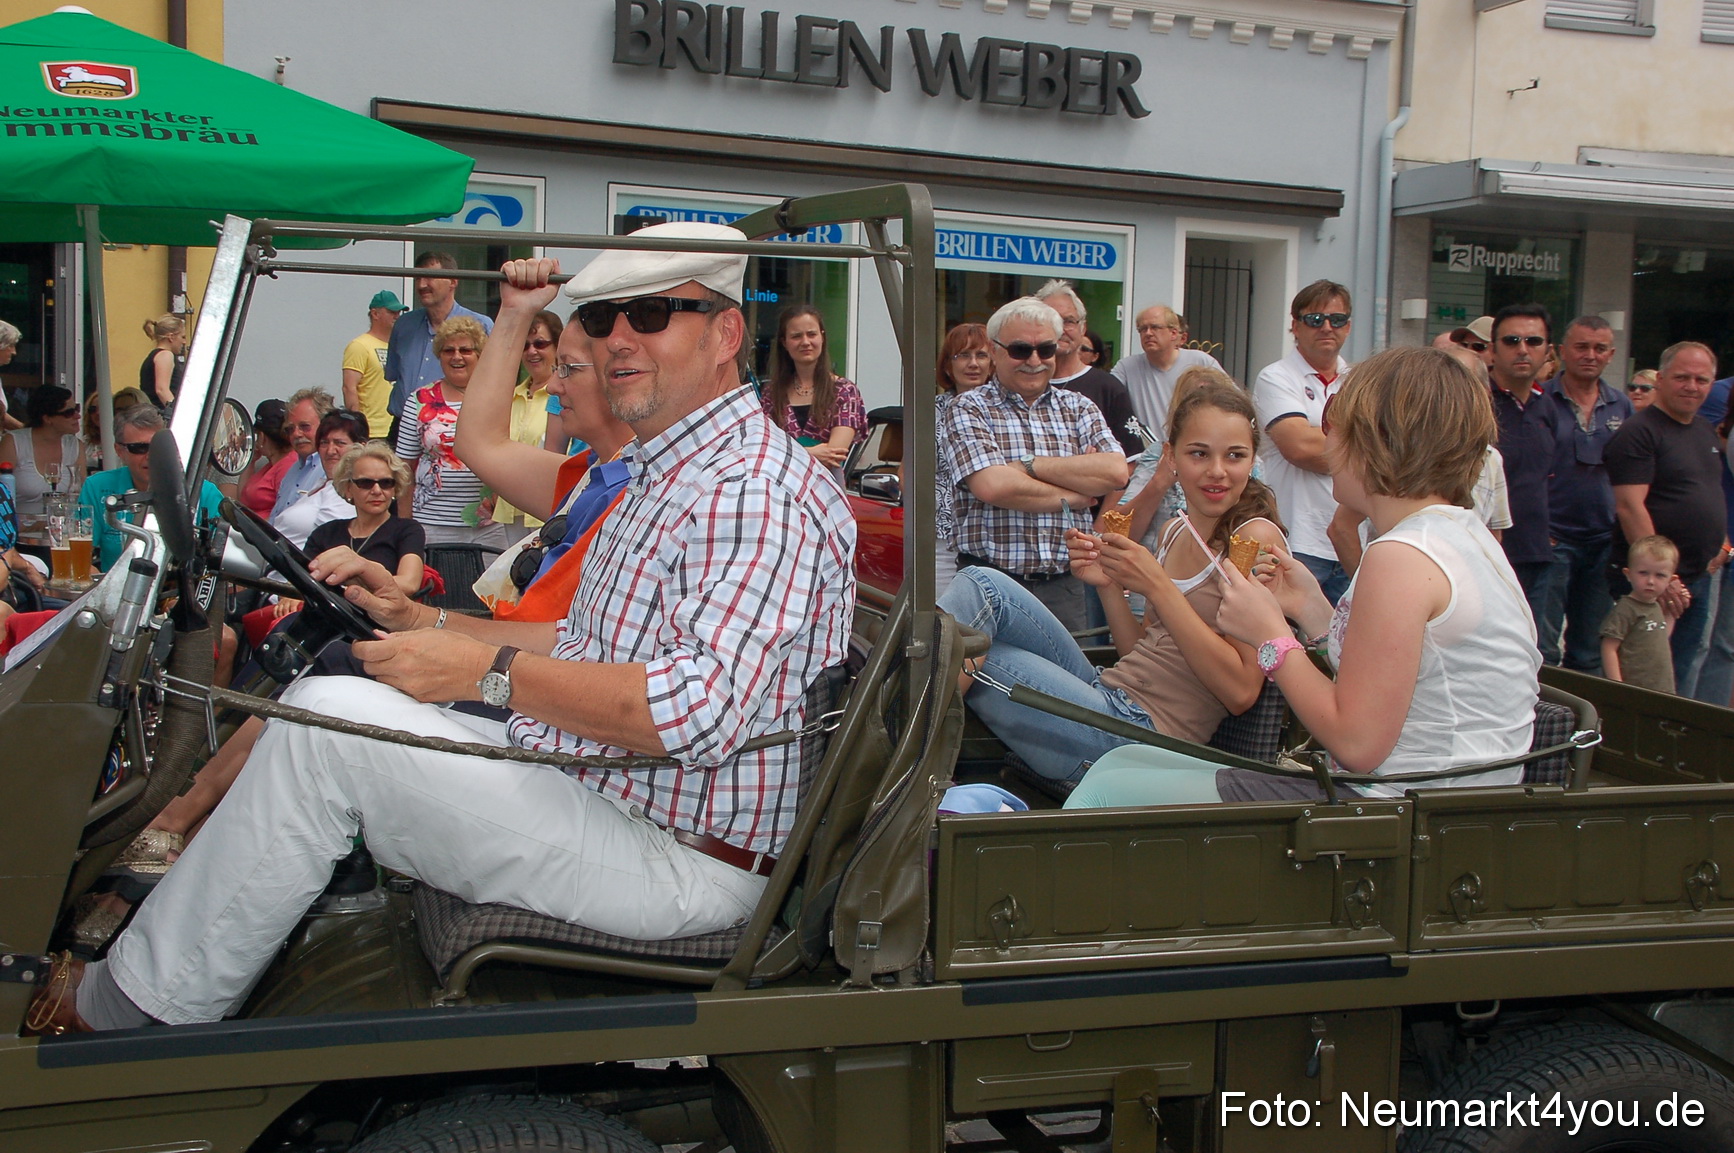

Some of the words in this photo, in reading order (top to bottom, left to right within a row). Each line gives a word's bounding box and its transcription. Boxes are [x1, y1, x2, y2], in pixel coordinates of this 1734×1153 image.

[612, 0, 895, 93] BRILLEN
[906, 26, 1152, 119] WEBER
[75, 89, 114, 97] 1628
[935, 231, 1022, 261] BRILLEN
[1029, 239, 1108, 268] WEBER
[1474, 245, 1560, 276] Rupprecht
[746, 288, 778, 302] Linie
[199, 575, 213, 606] ABU
